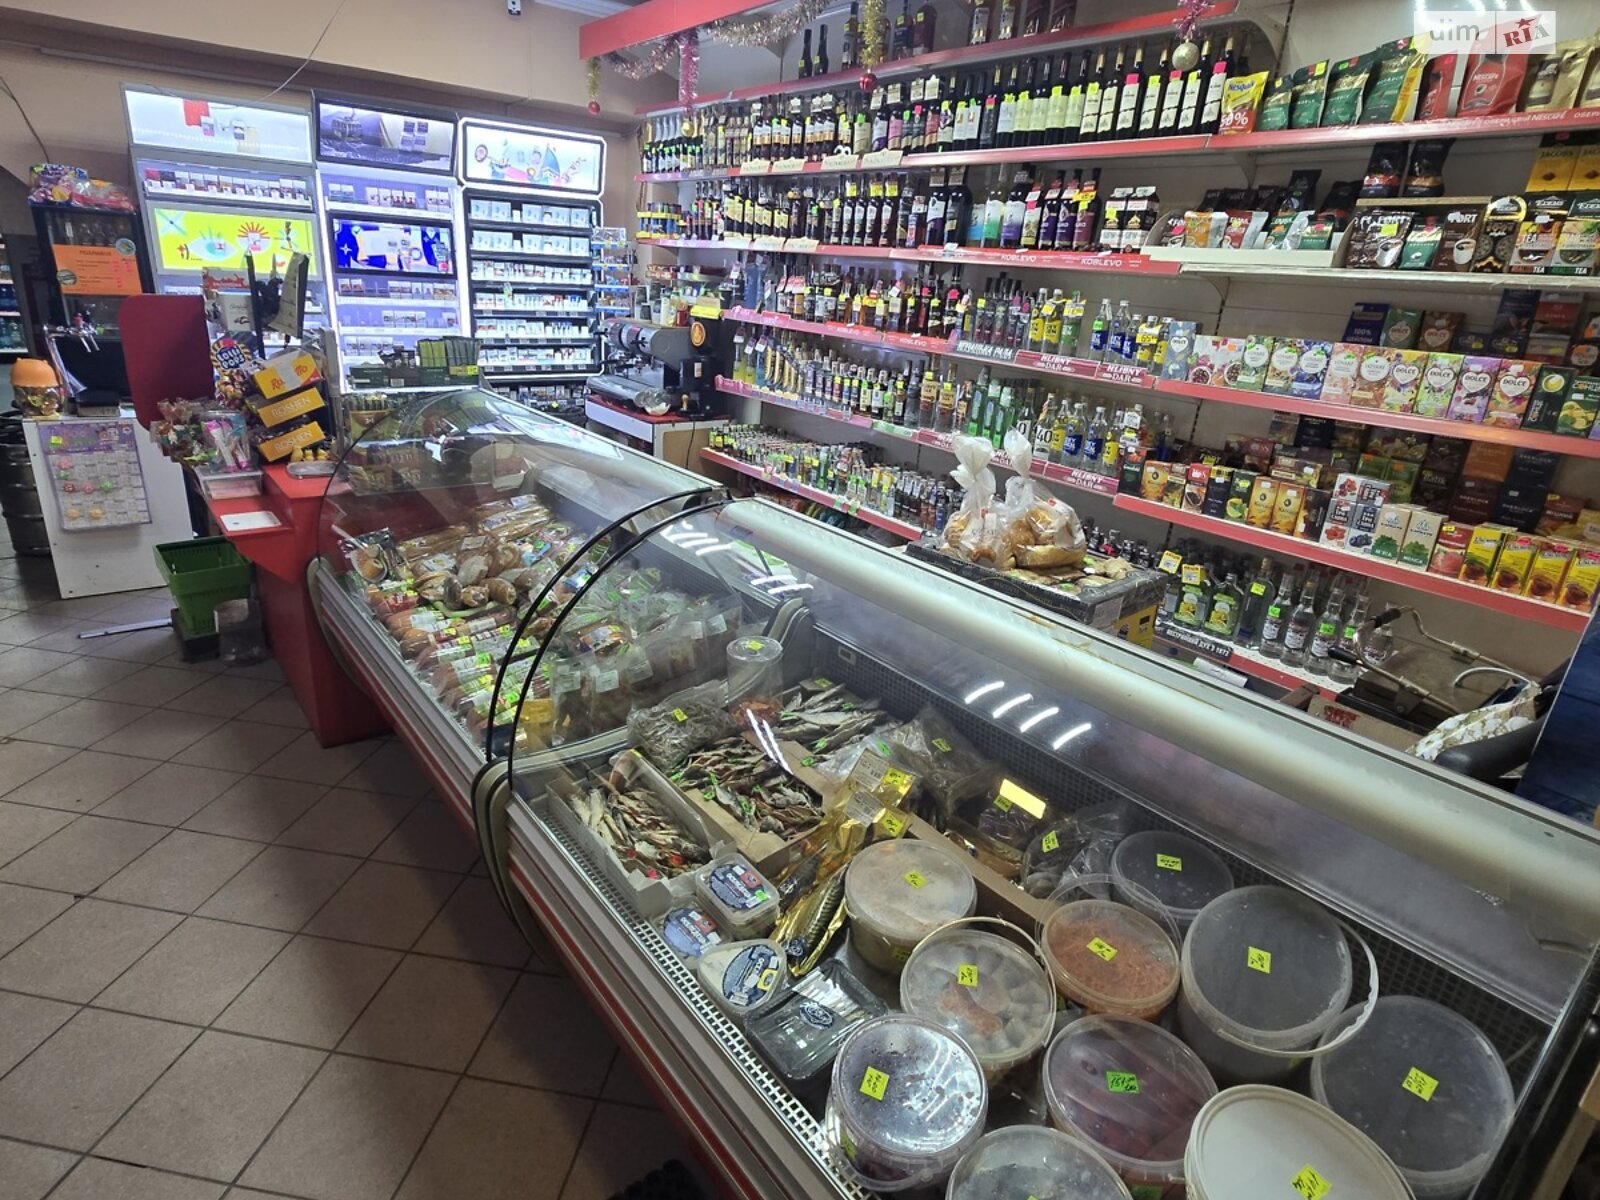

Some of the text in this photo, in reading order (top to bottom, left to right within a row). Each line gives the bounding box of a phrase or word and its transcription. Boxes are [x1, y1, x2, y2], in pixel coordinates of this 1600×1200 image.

[1001, 253, 1037, 263] KOBLEVO
[1080, 257, 1123, 268] KOBLEVO
[898, 337, 928, 348] KOBLEVO
[222, 353, 246, 369] POPS
[1040, 354, 1072, 366] HLIBNY
[1044, 362, 1064, 372] DAR
[1106, 364, 1143, 376] HLIBNY
[1395, 366, 1418, 375] DOLCE
[1111, 372, 1132, 383] DAR
[1429, 370, 1453, 380] DOLCE
[1464, 374, 1489, 384] DOLCE
[1502, 378, 1528, 388] DOLCE
[271, 396, 312, 418] ROSHEN
[1036, 426, 1053, 444] 40
